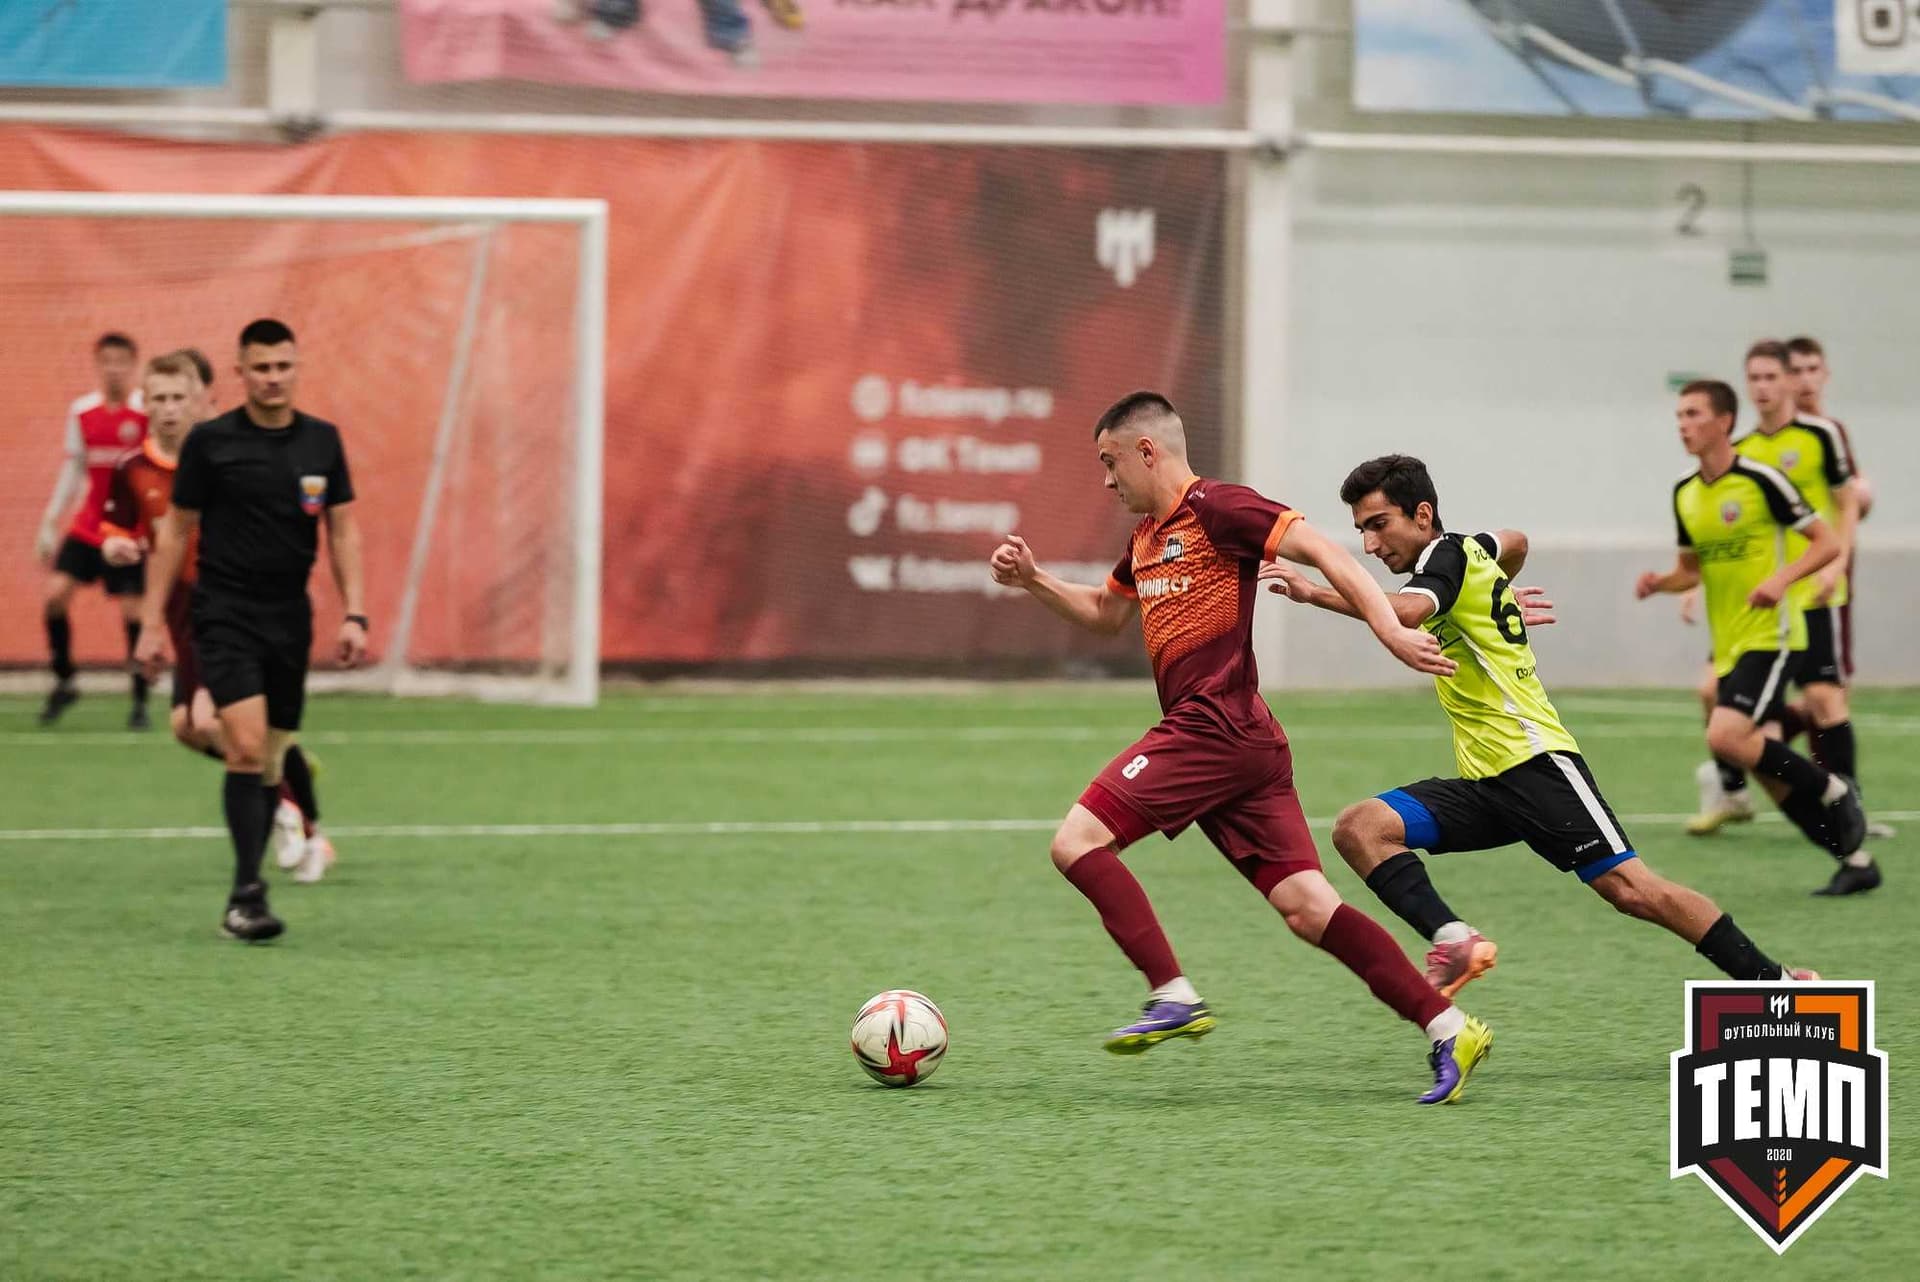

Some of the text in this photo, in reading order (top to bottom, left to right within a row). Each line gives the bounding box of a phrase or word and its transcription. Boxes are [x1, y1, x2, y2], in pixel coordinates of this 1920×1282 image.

[1675, 182, 1706, 237] 2
[1491, 577, 1528, 646] 6
[1121, 754, 1149, 780] 8
